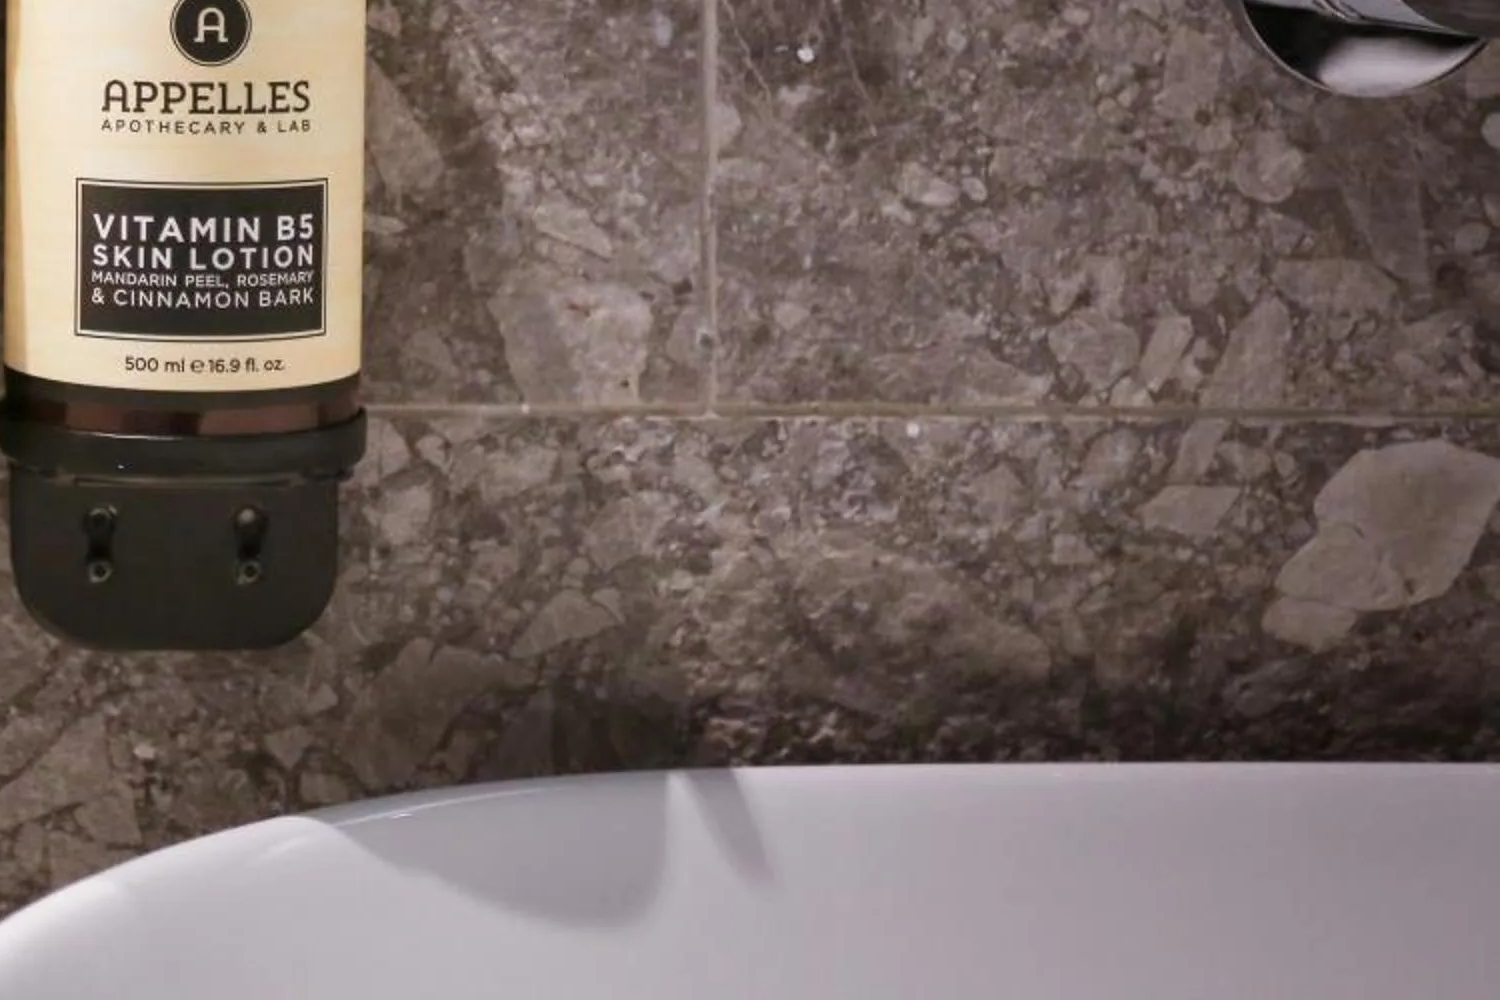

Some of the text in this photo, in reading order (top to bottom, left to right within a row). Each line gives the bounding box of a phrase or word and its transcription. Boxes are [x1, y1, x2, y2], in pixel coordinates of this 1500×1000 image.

[194, 7, 229, 44] A
[101, 79, 311, 115] APPELLES
[101, 119, 312, 135] APOTHECARY & LAB
[92, 213, 315, 244] VITAMIN B5
[92, 243, 314, 271] SKIN LOTION
[91, 270, 314, 289] MANDARIN PEEL, ROSEMARY
[91, 288, 315, 309] & CINNAMON BARK
[124, 357, 159, 373] 500
[164, 358, 185, 373] ml
[208, 359, 241, 374] 16.9
